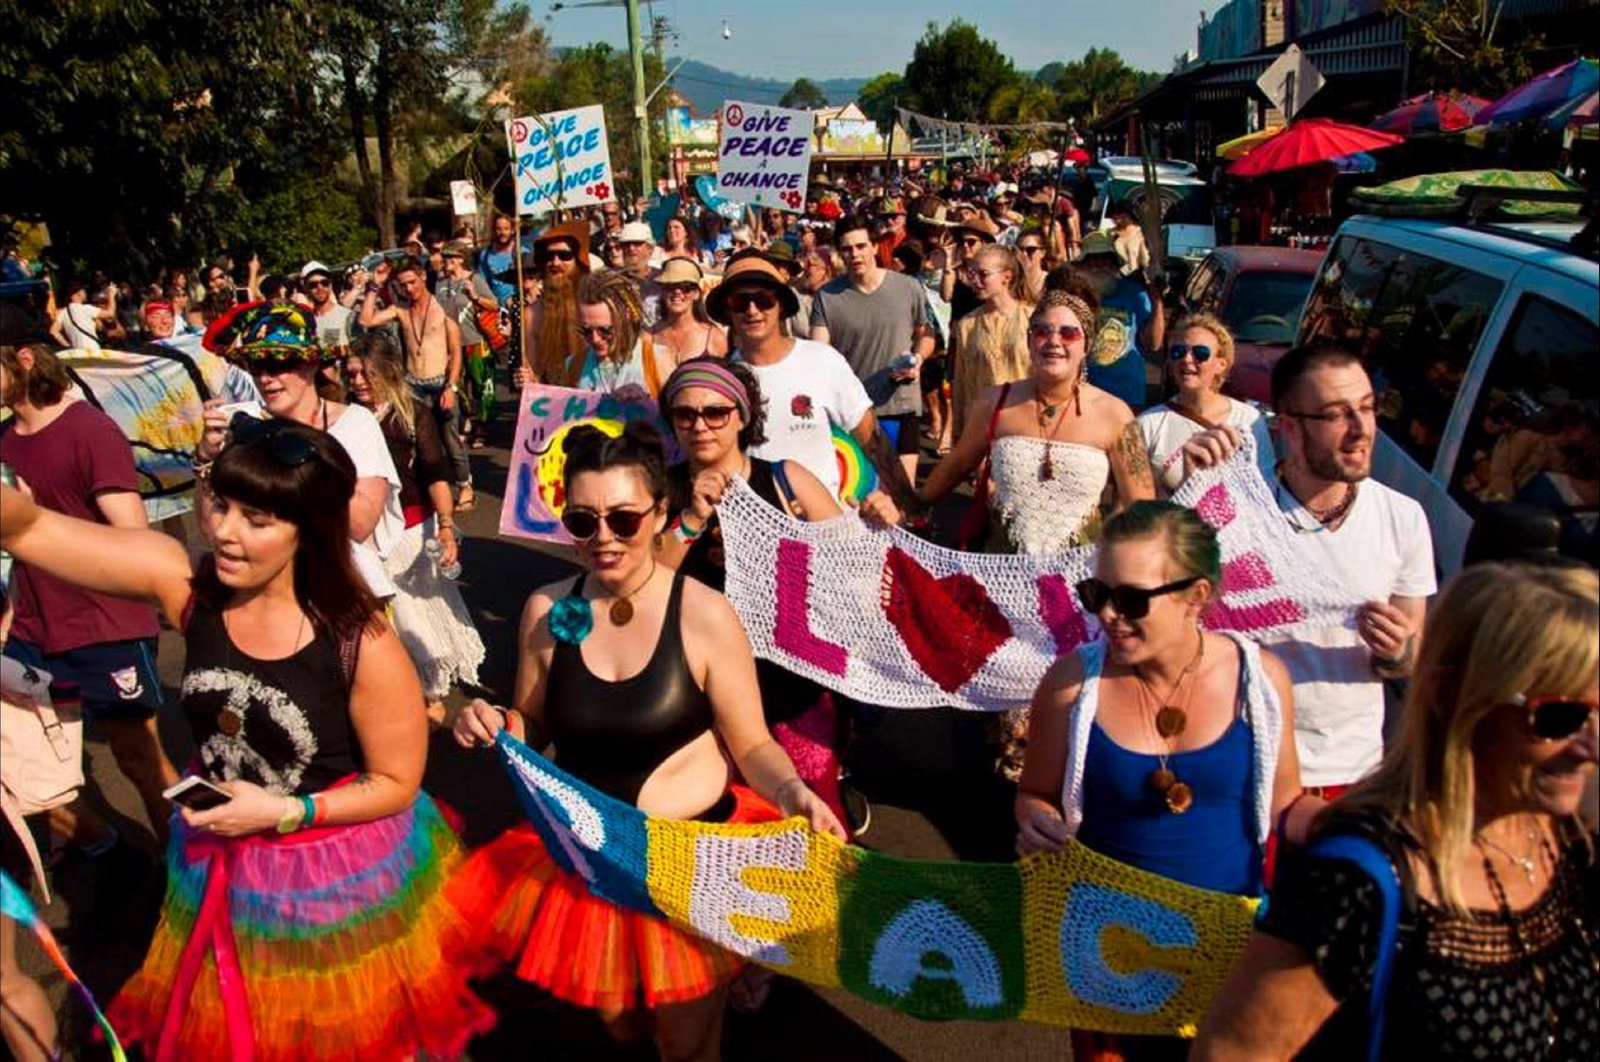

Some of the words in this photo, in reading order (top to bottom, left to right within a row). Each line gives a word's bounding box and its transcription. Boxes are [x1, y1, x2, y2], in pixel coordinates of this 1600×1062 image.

[529, 115, 577, 146] GIVE
[743, 116, 792, 132] GIVE
[517, 128, 601, 177] PEACE
[722, 136, 808, 157] PEACE
[523, 162, 606, 205] CHANCE
[721, 172, 802, 189] CHANCE
